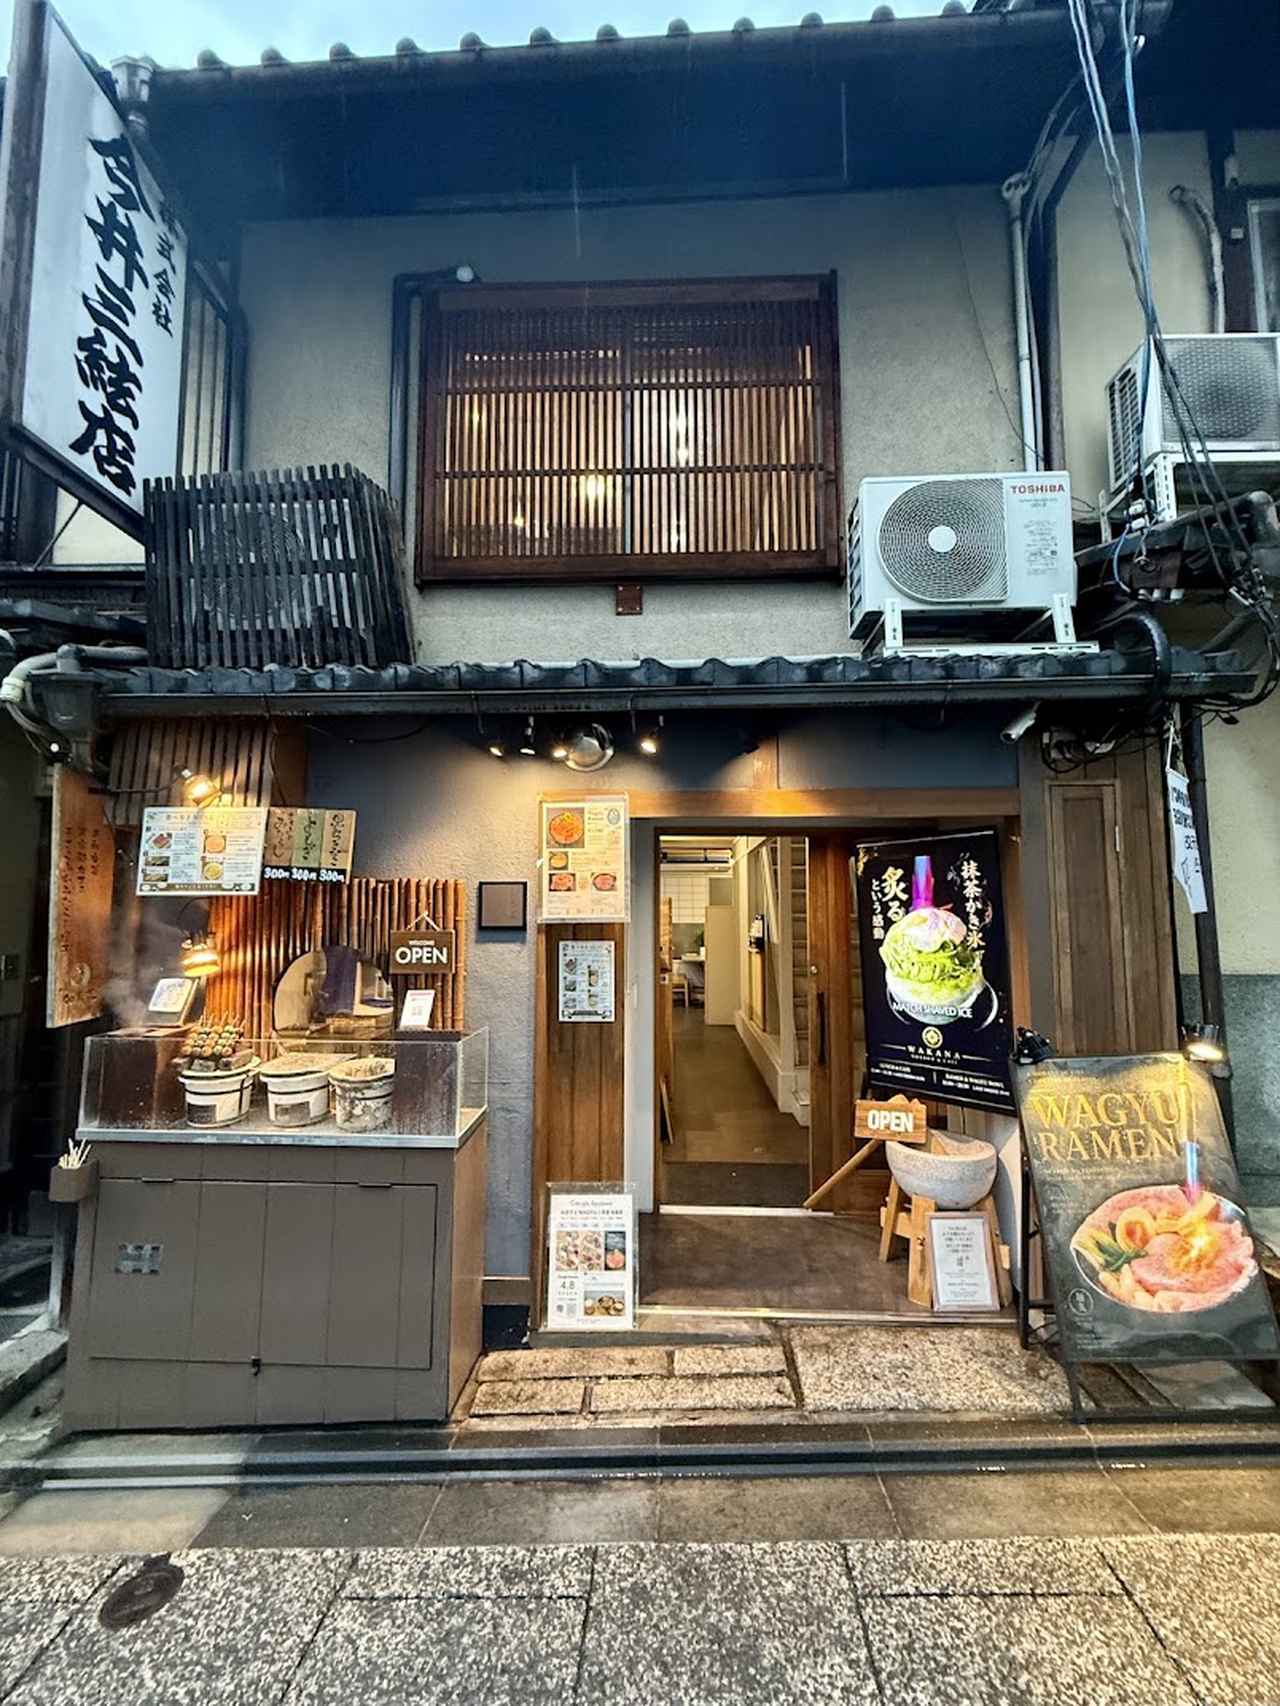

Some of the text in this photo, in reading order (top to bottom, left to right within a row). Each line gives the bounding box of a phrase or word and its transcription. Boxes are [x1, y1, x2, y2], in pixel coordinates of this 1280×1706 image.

[151, 196, 179, 337] 株式会社
[68, 133, 156, 497] 今井三絃店
[1010, 484, 1065, 494] TOSHIBA
[881, 866, 909, 922] 炙る
[961, 860, 987, 948] 抹茶かき氷
[395, 946, 448, 964] OPEN
[959, 1008, 973, 1018] ICE
[907, 1045, 961, 1060] WAKANA
[867, 1110, 914, 1133] OPEN
[1029, 1092, 1181, 1129] WAGYU
[1038, 1128, 1180, 1161] RAMEN
